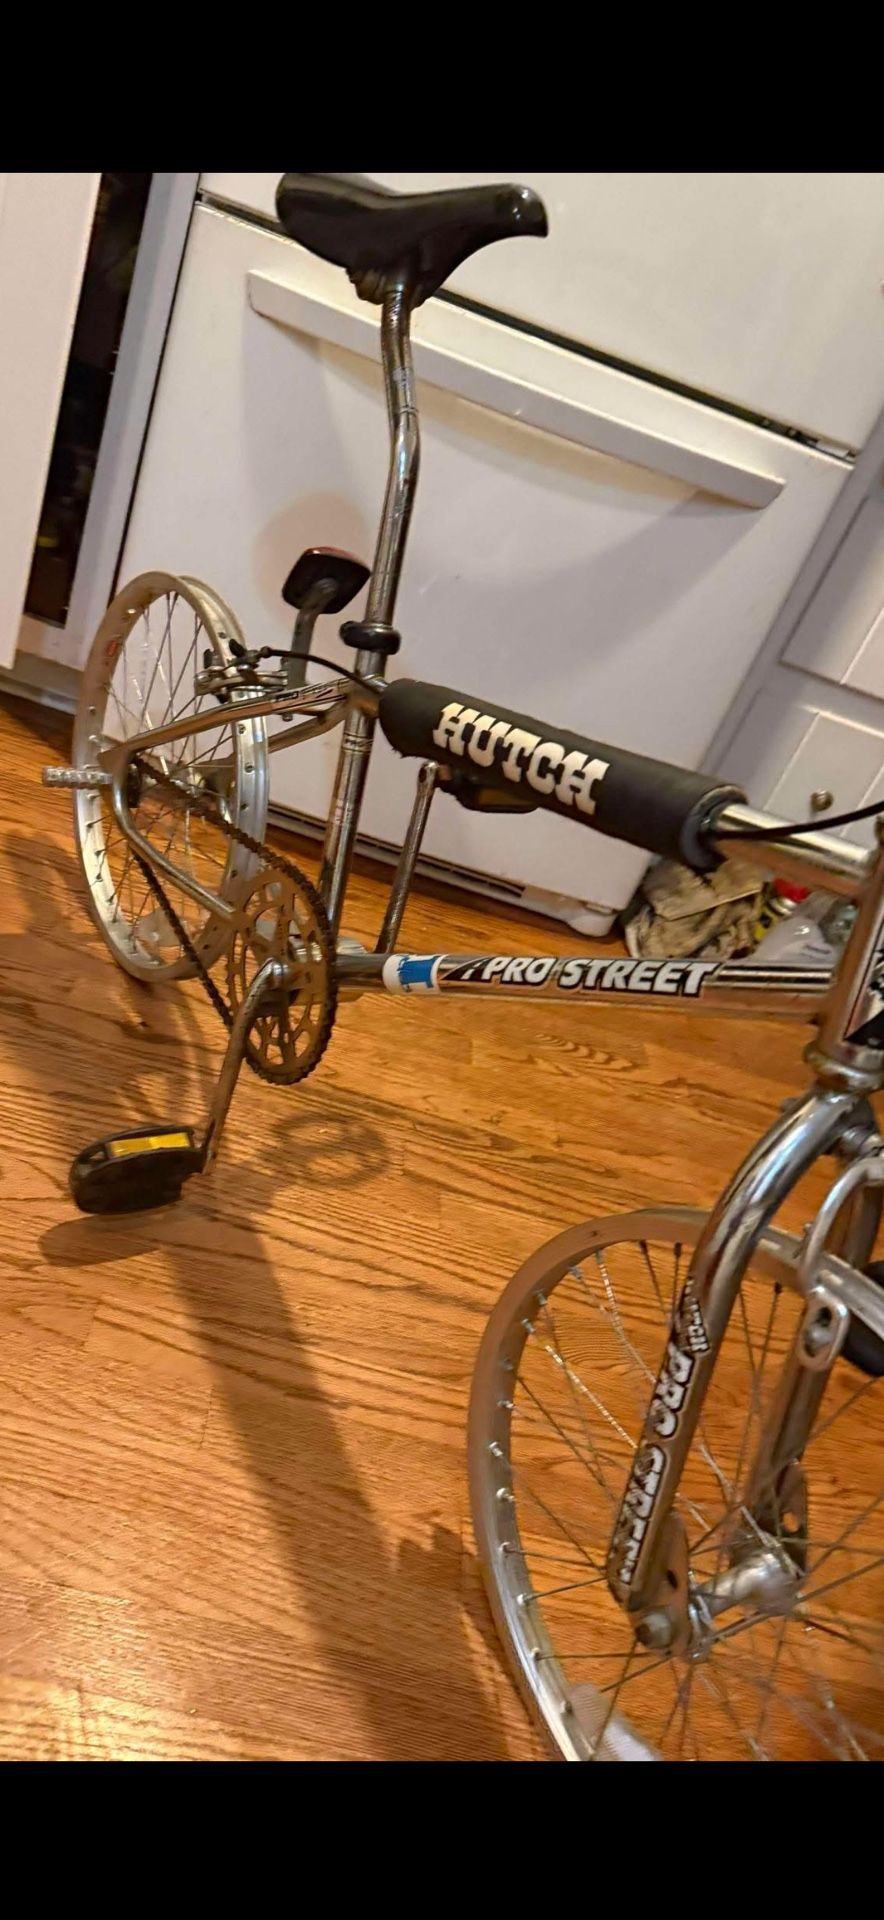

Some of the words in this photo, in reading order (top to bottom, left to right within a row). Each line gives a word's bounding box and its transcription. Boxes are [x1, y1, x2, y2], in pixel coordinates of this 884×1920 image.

[432, 702, 610, 815] HUTCH
[483, 957, 551, 984] PRO
[559, 959, 715, 994] STREET
